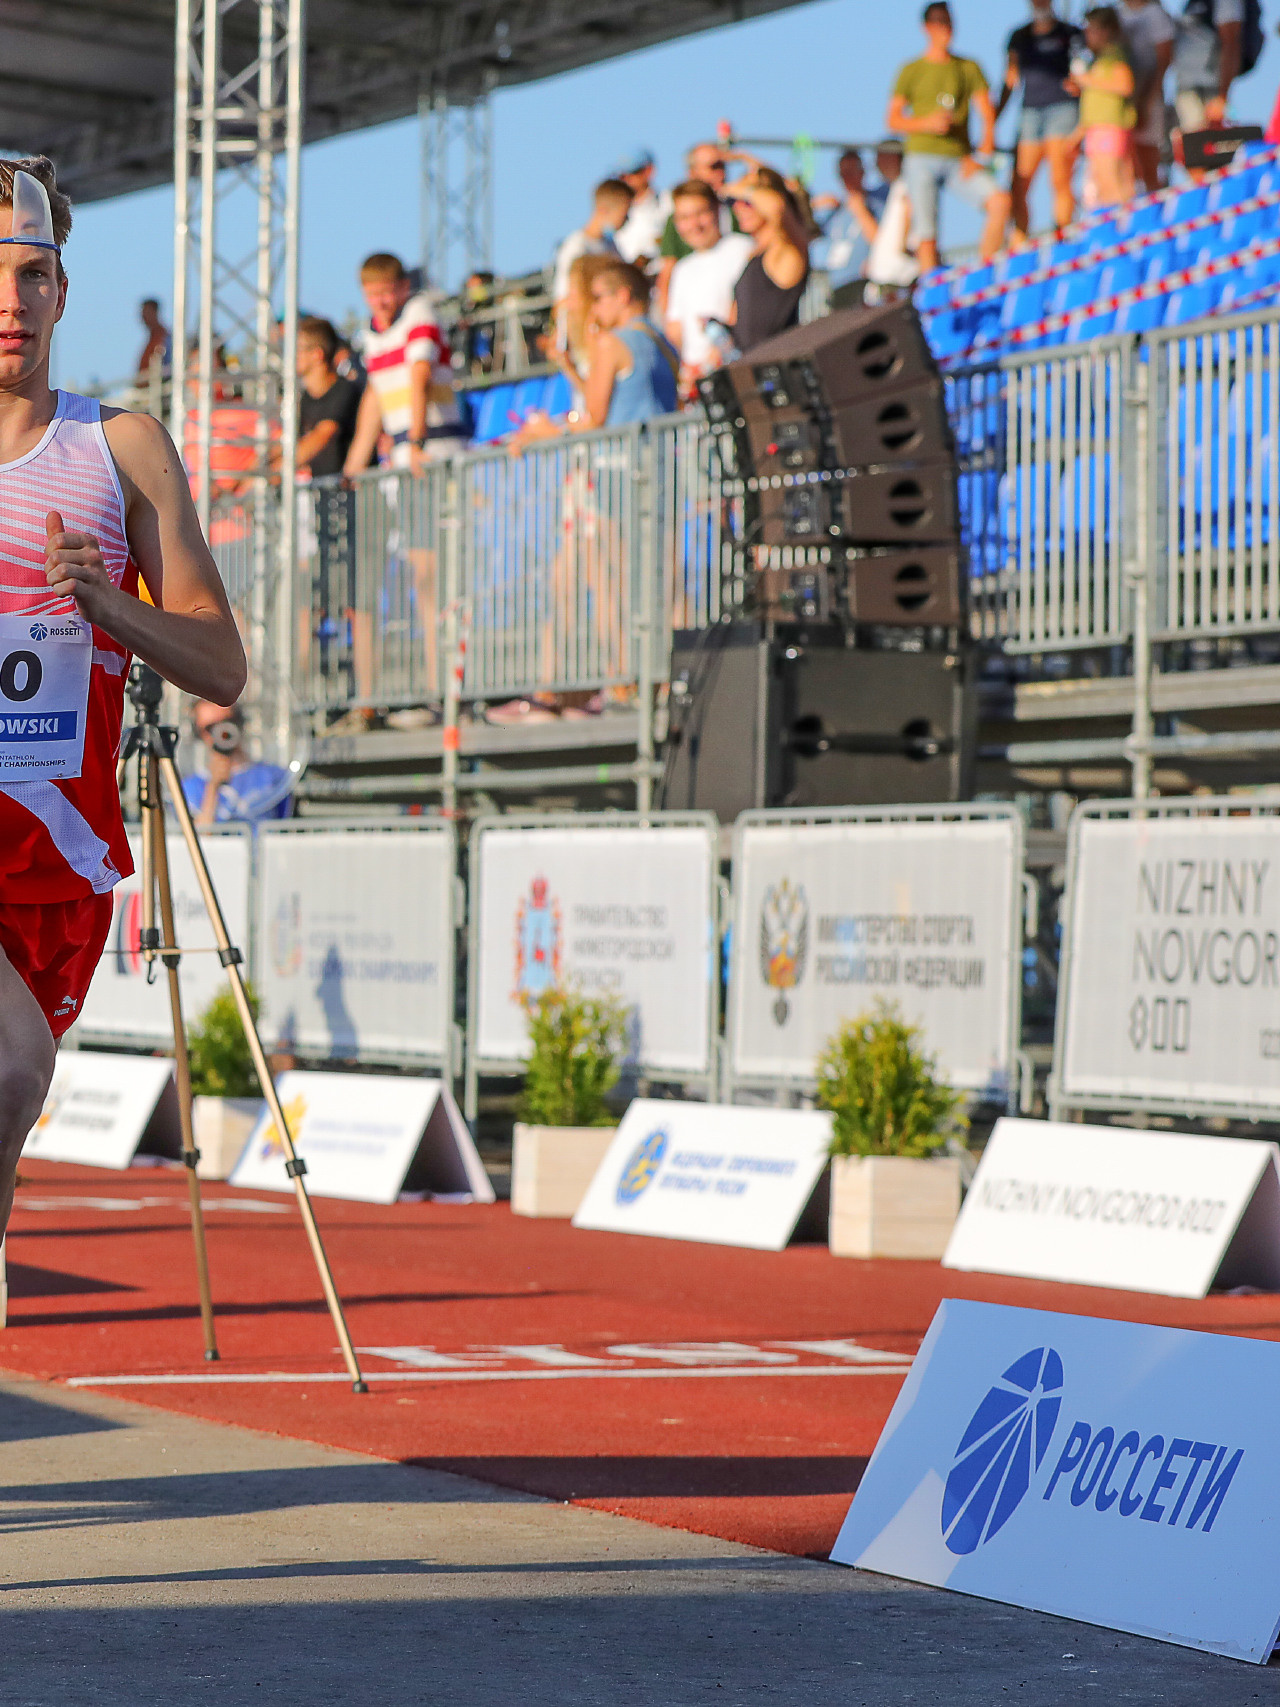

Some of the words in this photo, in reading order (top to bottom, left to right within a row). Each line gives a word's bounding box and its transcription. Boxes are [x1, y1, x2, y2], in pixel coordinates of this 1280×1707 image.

[50, 628, 79, 636] ROSSETI
[1137, 859, 1269, 916] NIZHNY
[1128, 995, 1190, 1052] 800
[1042, 1421, 1245, 1533] РОССЕТИ
